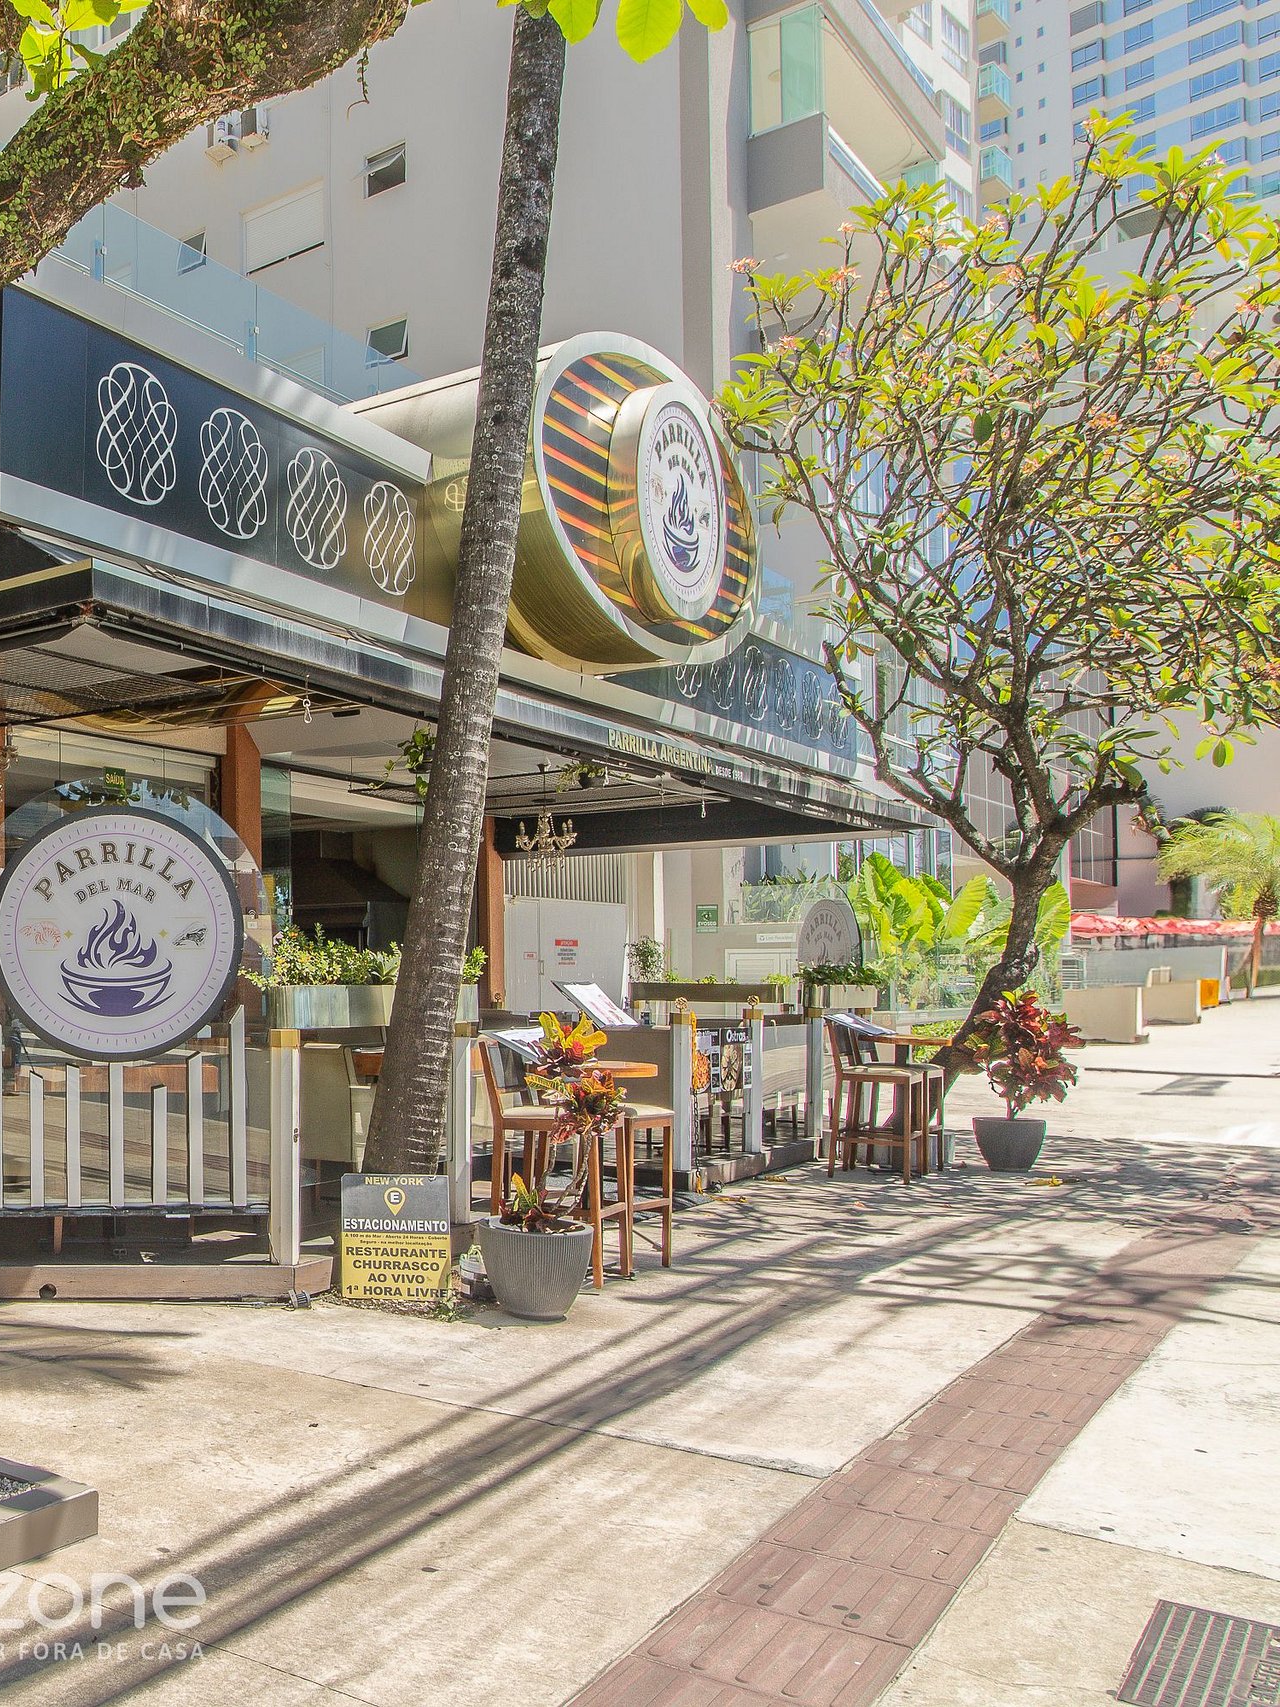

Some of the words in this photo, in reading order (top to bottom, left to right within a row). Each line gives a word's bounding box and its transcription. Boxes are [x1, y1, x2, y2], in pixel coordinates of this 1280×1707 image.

[655, 423, 706, 489] PARRILLA
[608, 728, 660, 759] PARRILLA
[660, 743, 714, 774] ARGENTINA
[105, 771, 125, 785] SAÍDA
[33, 841, 195, 902] PARRILLA
[74, 878, 110, 904] DEL
[116, 877, 157, 904] MAR
[365, 1176, 389, 1185] NEW
[394, 1177, 424, 1186] YORK
[390, 1192, 400, 1203] E
[343, 1218, 448, 1232] ESTACIONAMENTO
[346, 1247, 447, 1259] RESTAURANTE
[353, 1260, 440, 1272] CHURRASCO
[368, 1273, 387, 1283] AO
[391, 1274, 425, 1284] VIVO
[346, 1285, 359, 1295] 1ª
[363, 1286, 403, 1297] HORA
[407, 1287, 449, 1298] LIVRE
